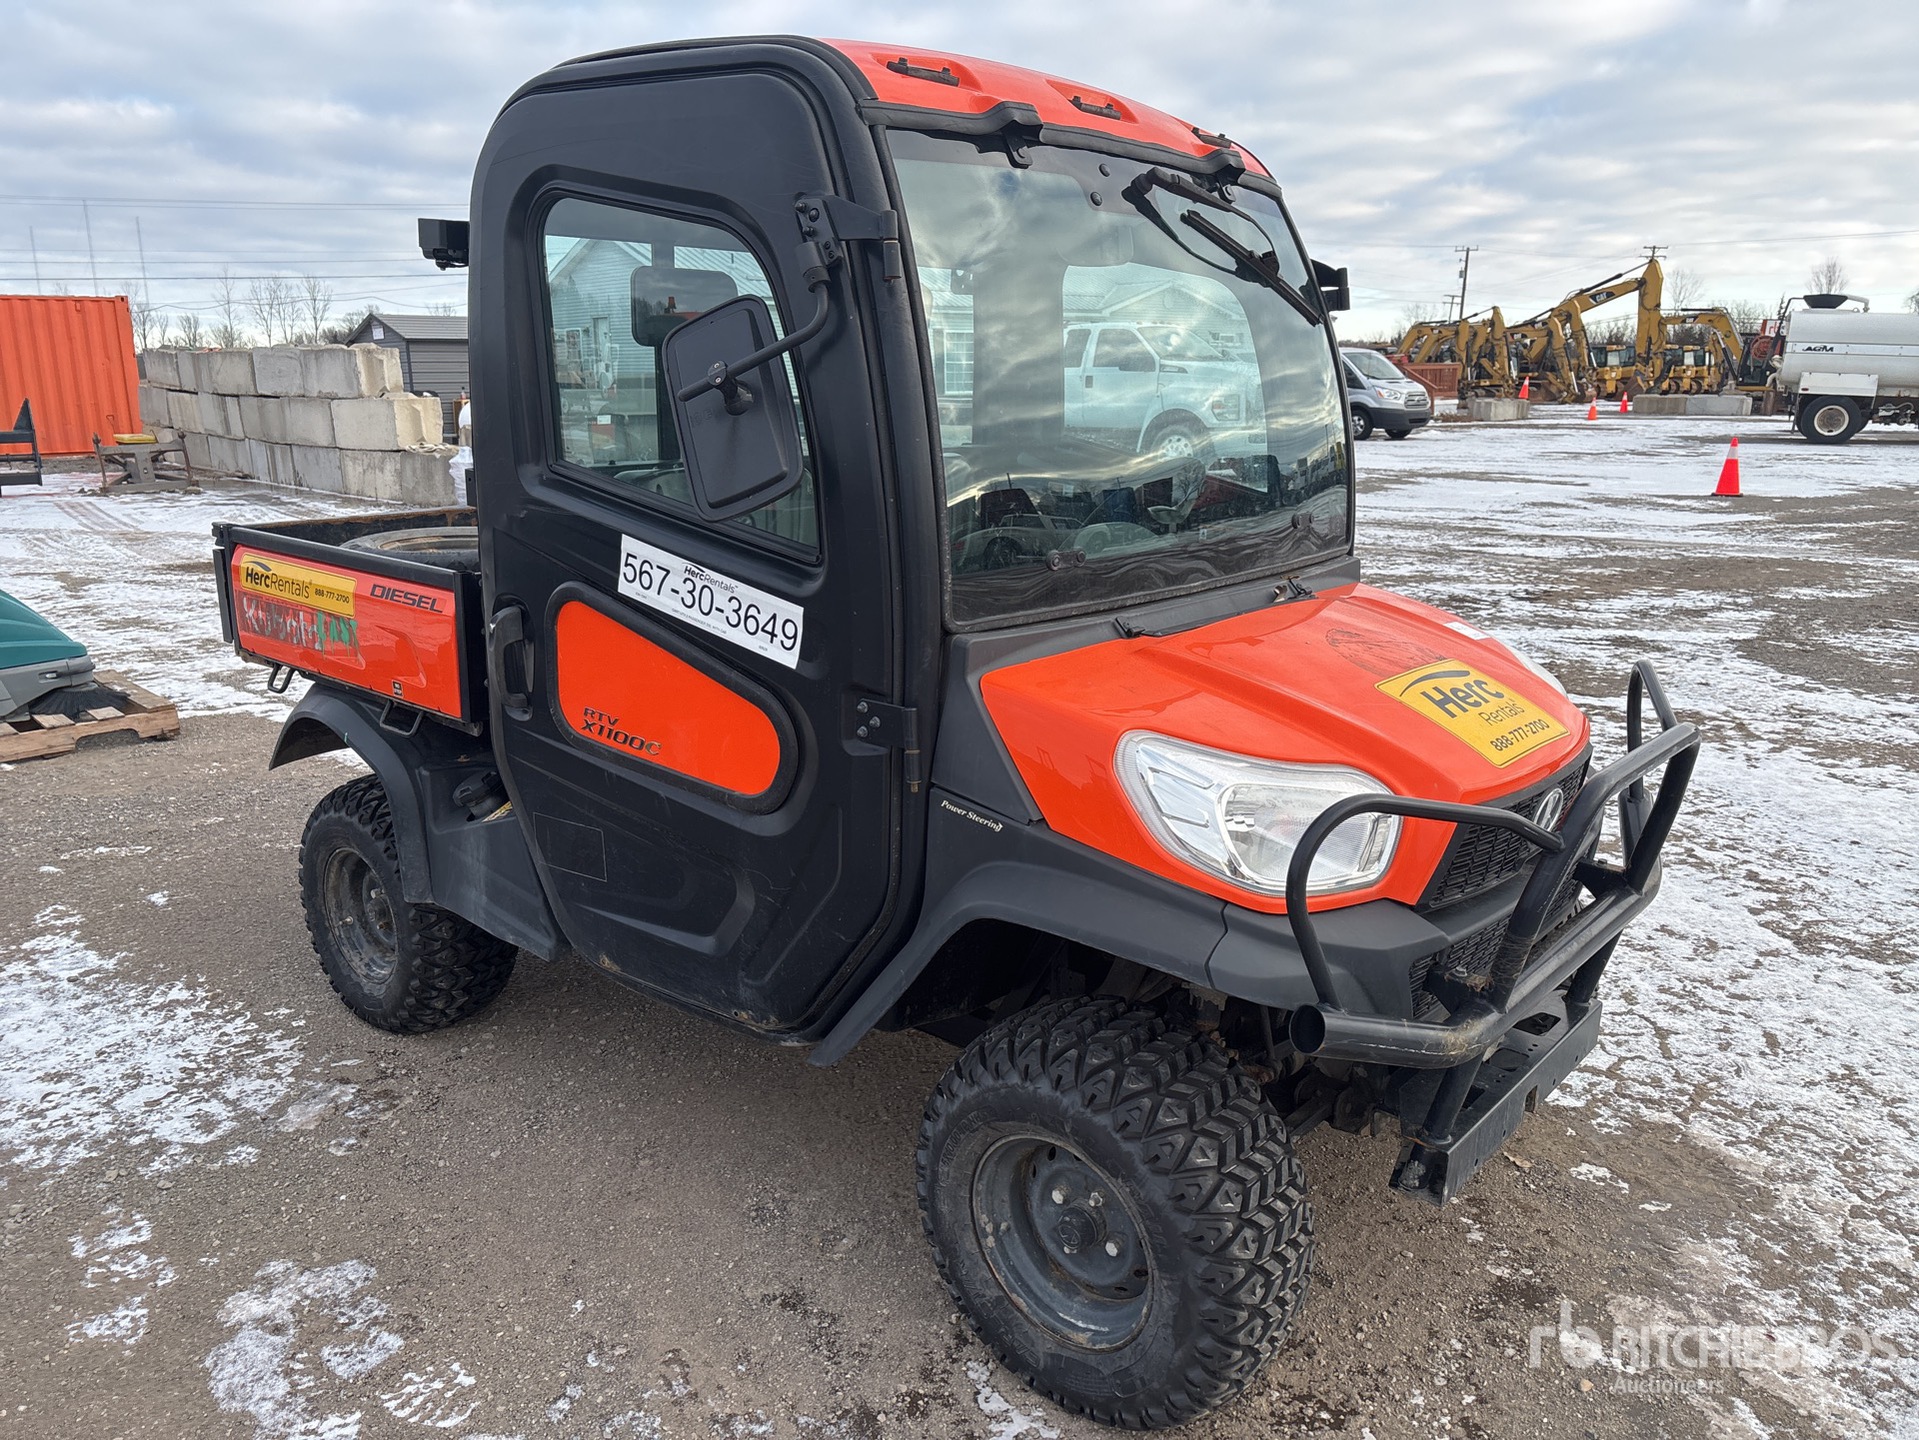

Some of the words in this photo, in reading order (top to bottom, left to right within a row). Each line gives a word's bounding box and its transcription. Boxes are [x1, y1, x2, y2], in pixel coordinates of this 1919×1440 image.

[314, 587, 350, 604] 888-777-2700
[370, 583, 443, 614] DIESEL
[622, 552, 799, 652] 567-30-3649
[1420, 680, 1505, 719] Herc
[1478, 701, 1525, 727] Rentals
[583, 707, 619, 726] RTV
[581, 719, 662, 756] X1100C
[1490, 719, 1550, 752] 888-777-2700
[940, 800, 967, 816] Power
[966, 810, 1003, 832] Steering
